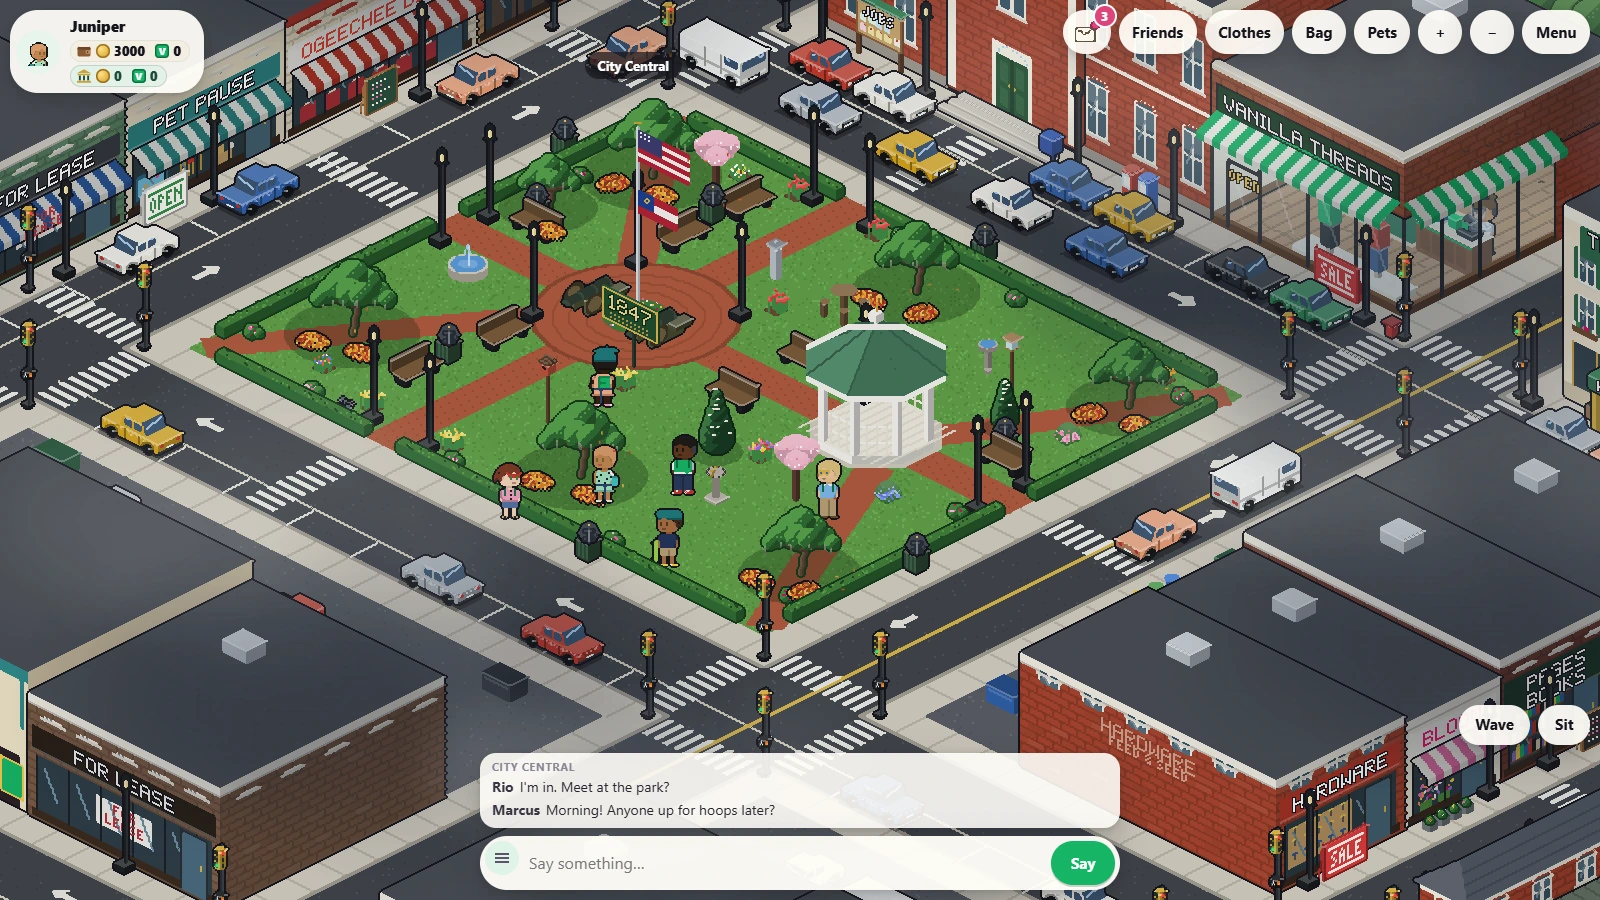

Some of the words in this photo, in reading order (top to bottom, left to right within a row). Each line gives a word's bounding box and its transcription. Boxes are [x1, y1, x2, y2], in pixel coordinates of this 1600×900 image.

[302, 0, 396, 59] OGEECHEE
[863, 6, 894, 29] JOBS
[153, 102, 188, 134] PET
[196, 70, 255, 113] PAUSE
[1223, 95, 1303, 148] VANILLA
[1310, 138, 1393, 192] THREADS
[0, 184, 28, 207] OR
[36, 150, 95, 194] LEASE
[1228, 169, 1260, 194] OPEN
[149, 184, 183, 213] OPEN
[1320, 262, 1352, 292] SALE
[608, 295, 652, 325] 1847
[1101, 717, 1195, 777] HARDWARE
[74, 750, 108, 781] FOR
[1292, 751, 1388, 812] HRDWARE
[105, 812, 144, 841] LESE
[113, 804, 135, 825] FR
[1330, 838, 1362, 868] SALE
